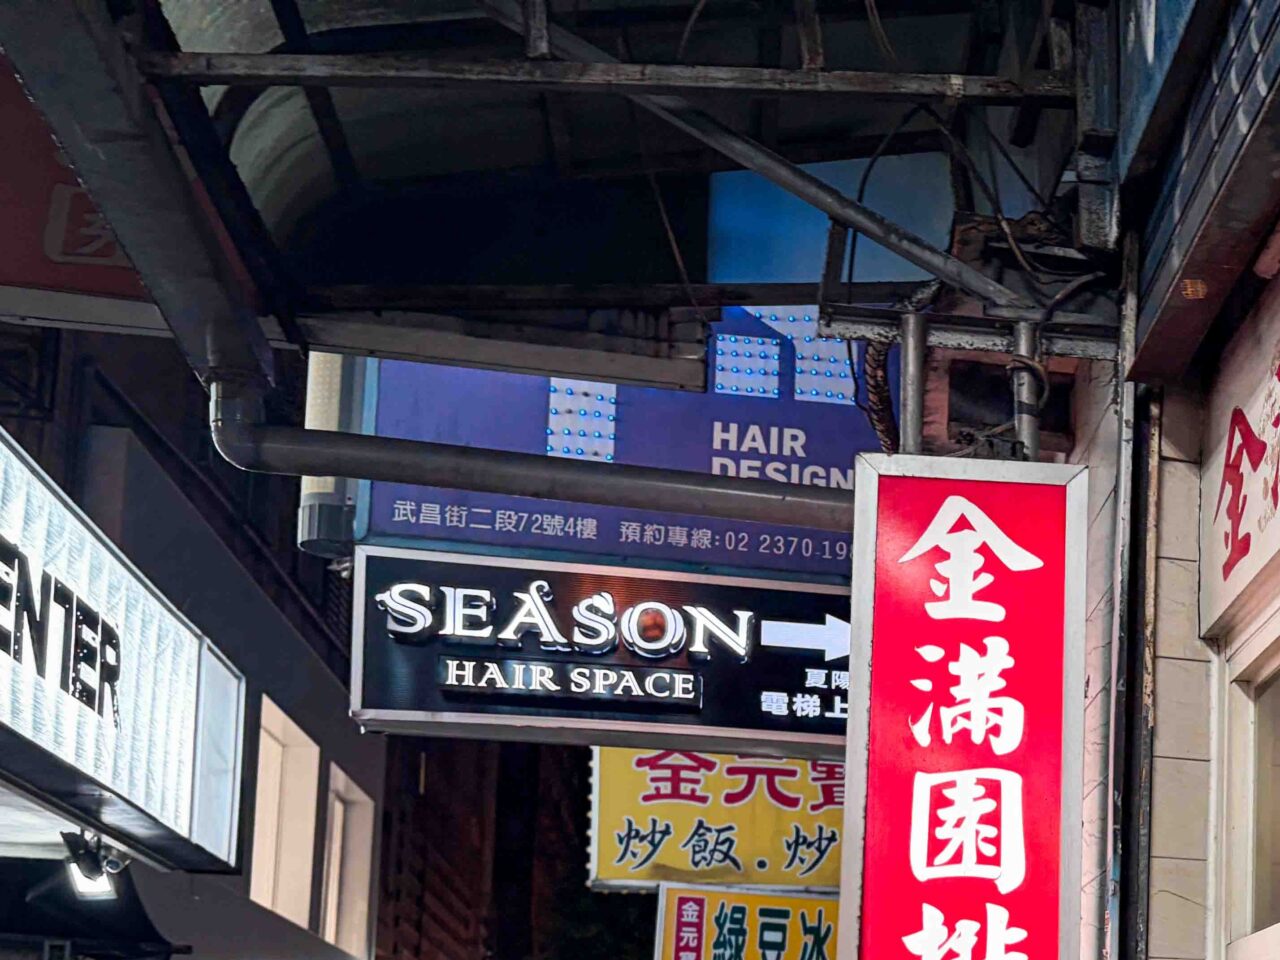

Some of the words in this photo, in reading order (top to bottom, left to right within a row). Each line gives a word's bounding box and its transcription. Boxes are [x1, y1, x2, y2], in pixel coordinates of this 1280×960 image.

[713, 421, 807, 457] HAIR
[392, 500, 598, 540] 武昌街二段72號4樓
[759, 535, 854, 560] 2370-19
[375, 579, 754, 664] SEASON
[444, 659, 560, 692] HAIR
[569, 666, 697, 700] SPACE
[761, 691, 848, 718] 電梯上
